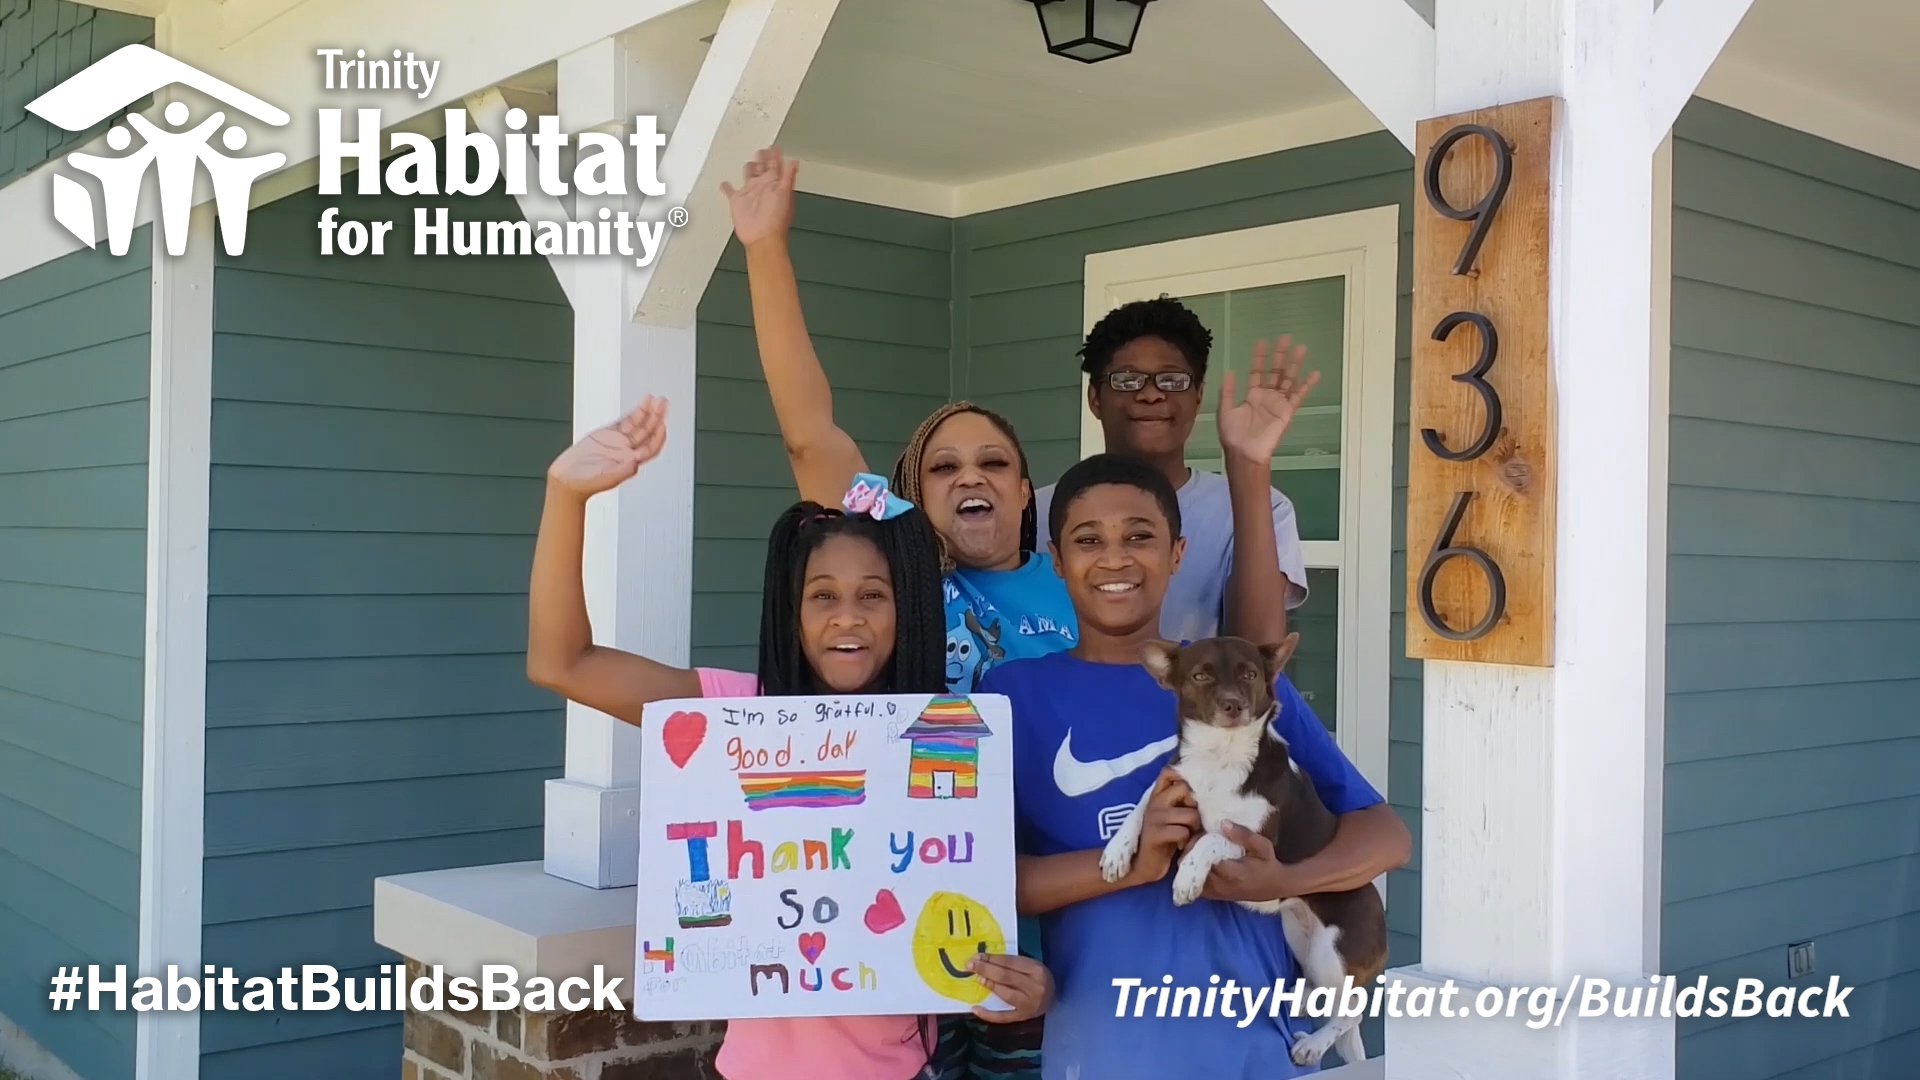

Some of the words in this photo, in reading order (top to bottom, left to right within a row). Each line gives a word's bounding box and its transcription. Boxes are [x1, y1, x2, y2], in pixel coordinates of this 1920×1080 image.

[1421, 124, 1512, 640] 936
[722, 707, 765, 726] I'm
[666, 820, 855, 883] Thank
[889, 831, 974, 873] you
[750, 961, 877, 996] much
